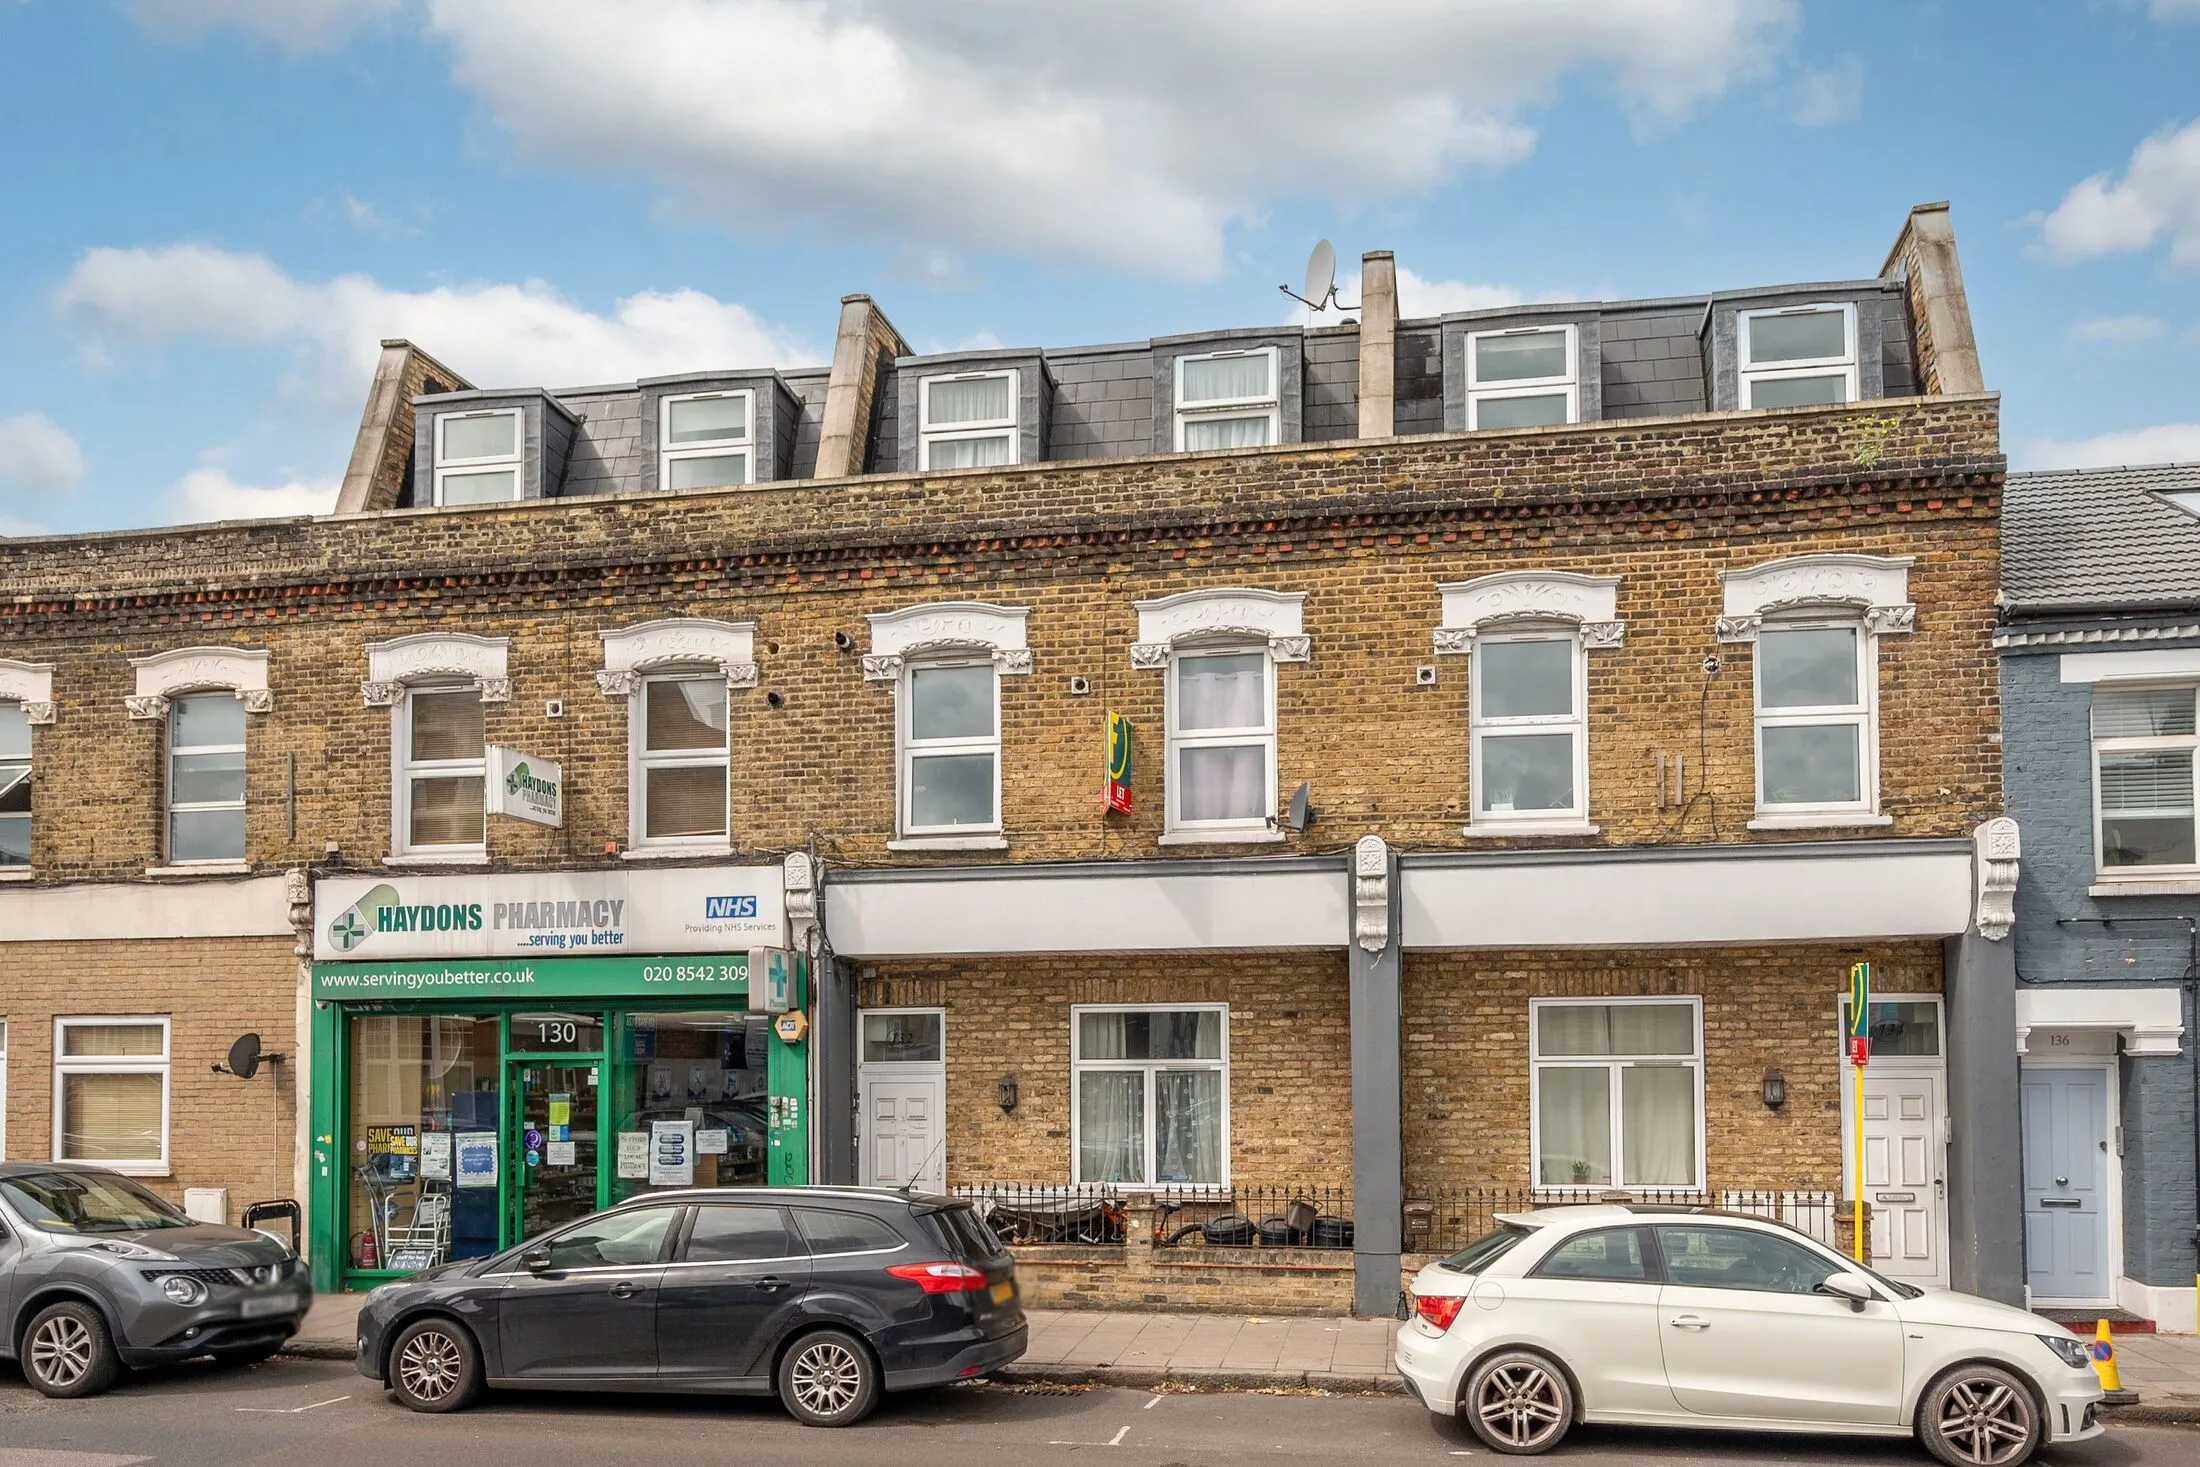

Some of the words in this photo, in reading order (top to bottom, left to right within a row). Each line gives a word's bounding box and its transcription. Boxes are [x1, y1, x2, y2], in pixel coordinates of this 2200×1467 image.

[522, 774, 557, 797] HAYDONS
[378, 904, 482, 932] HAYDONS
[493, 899, 625, 929] PHARMACY
[707, 897, 755, 917] NHS
[684, 923, 723, 933] Providing
[724, 923, 742, 932] NHS
[743, 921, 776, 931] Services
[569, 934, 588, 949] you
[591, 929, 624, 945] better
[320, 967, 534, 990] www.servingyoubetter.co.uk
[643, 966, 673, 982] 020
[676, 965, 715, 981] 8542
[719, 965, 749, 980] 309
[538, 1022, 577, 1043] 130
[781, 1021, 796, 1030] ADT
[2050, 1035, 2070, 1046] 136
[368, 1128, 392, 1143] SAVE
[390, 1135, 405, 1147] SAVE
[405, 1135, 418, 1147] OUR
